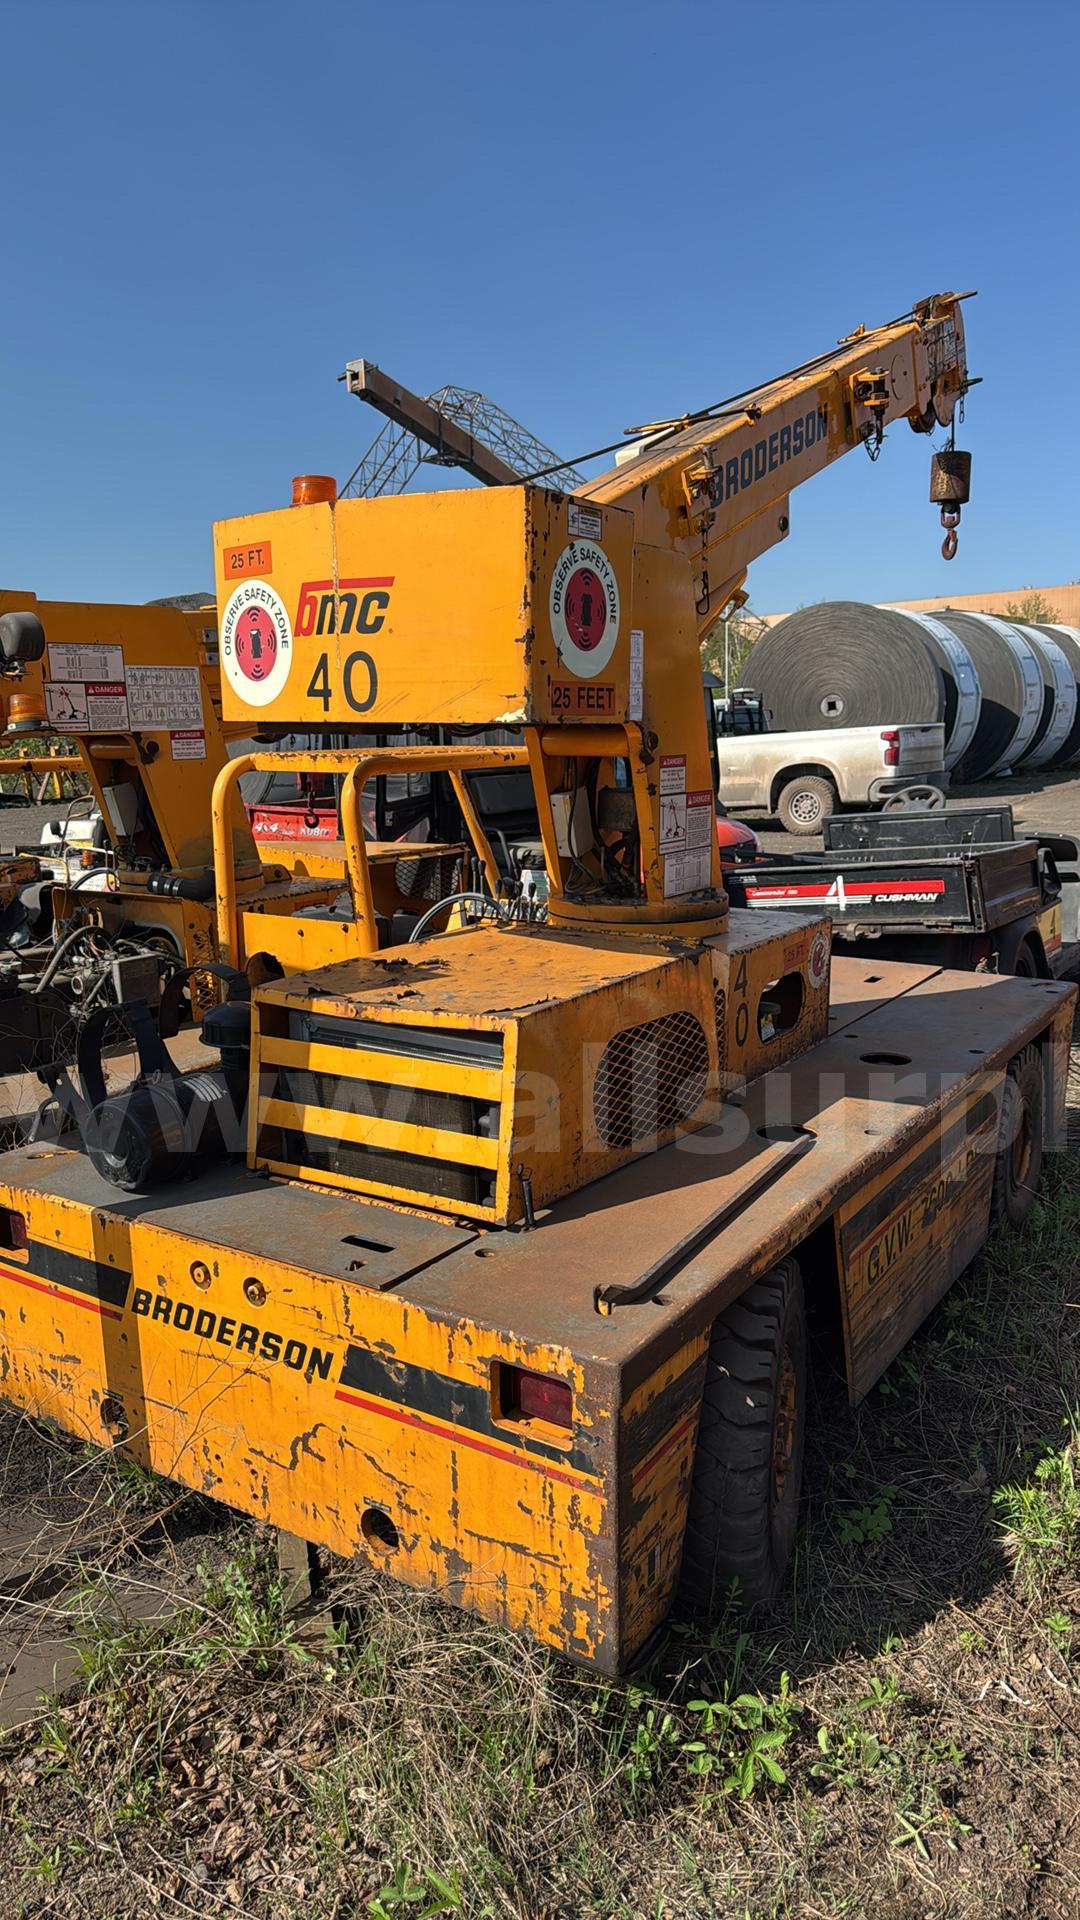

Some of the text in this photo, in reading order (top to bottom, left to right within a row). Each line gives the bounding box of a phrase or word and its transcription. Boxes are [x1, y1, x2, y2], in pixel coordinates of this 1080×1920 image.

[231, 549, 264, 569] 25 FT.
[553, 547, 617, 624] OBSERVE SAFETY ZONE
[224, 587, 289, 656] OBSERVE SAFETY ZONE
[94, 686, 123, 694] DANGER
[307, 651, 378, 712] 40
[552, 687, 614, 709] 25 FEET
[875, 893, 939, 902] CUSHMAN
[868, 1209, 914, 1285] G.V.W.
[131, 1287, 335, 1381] BRODERSON
